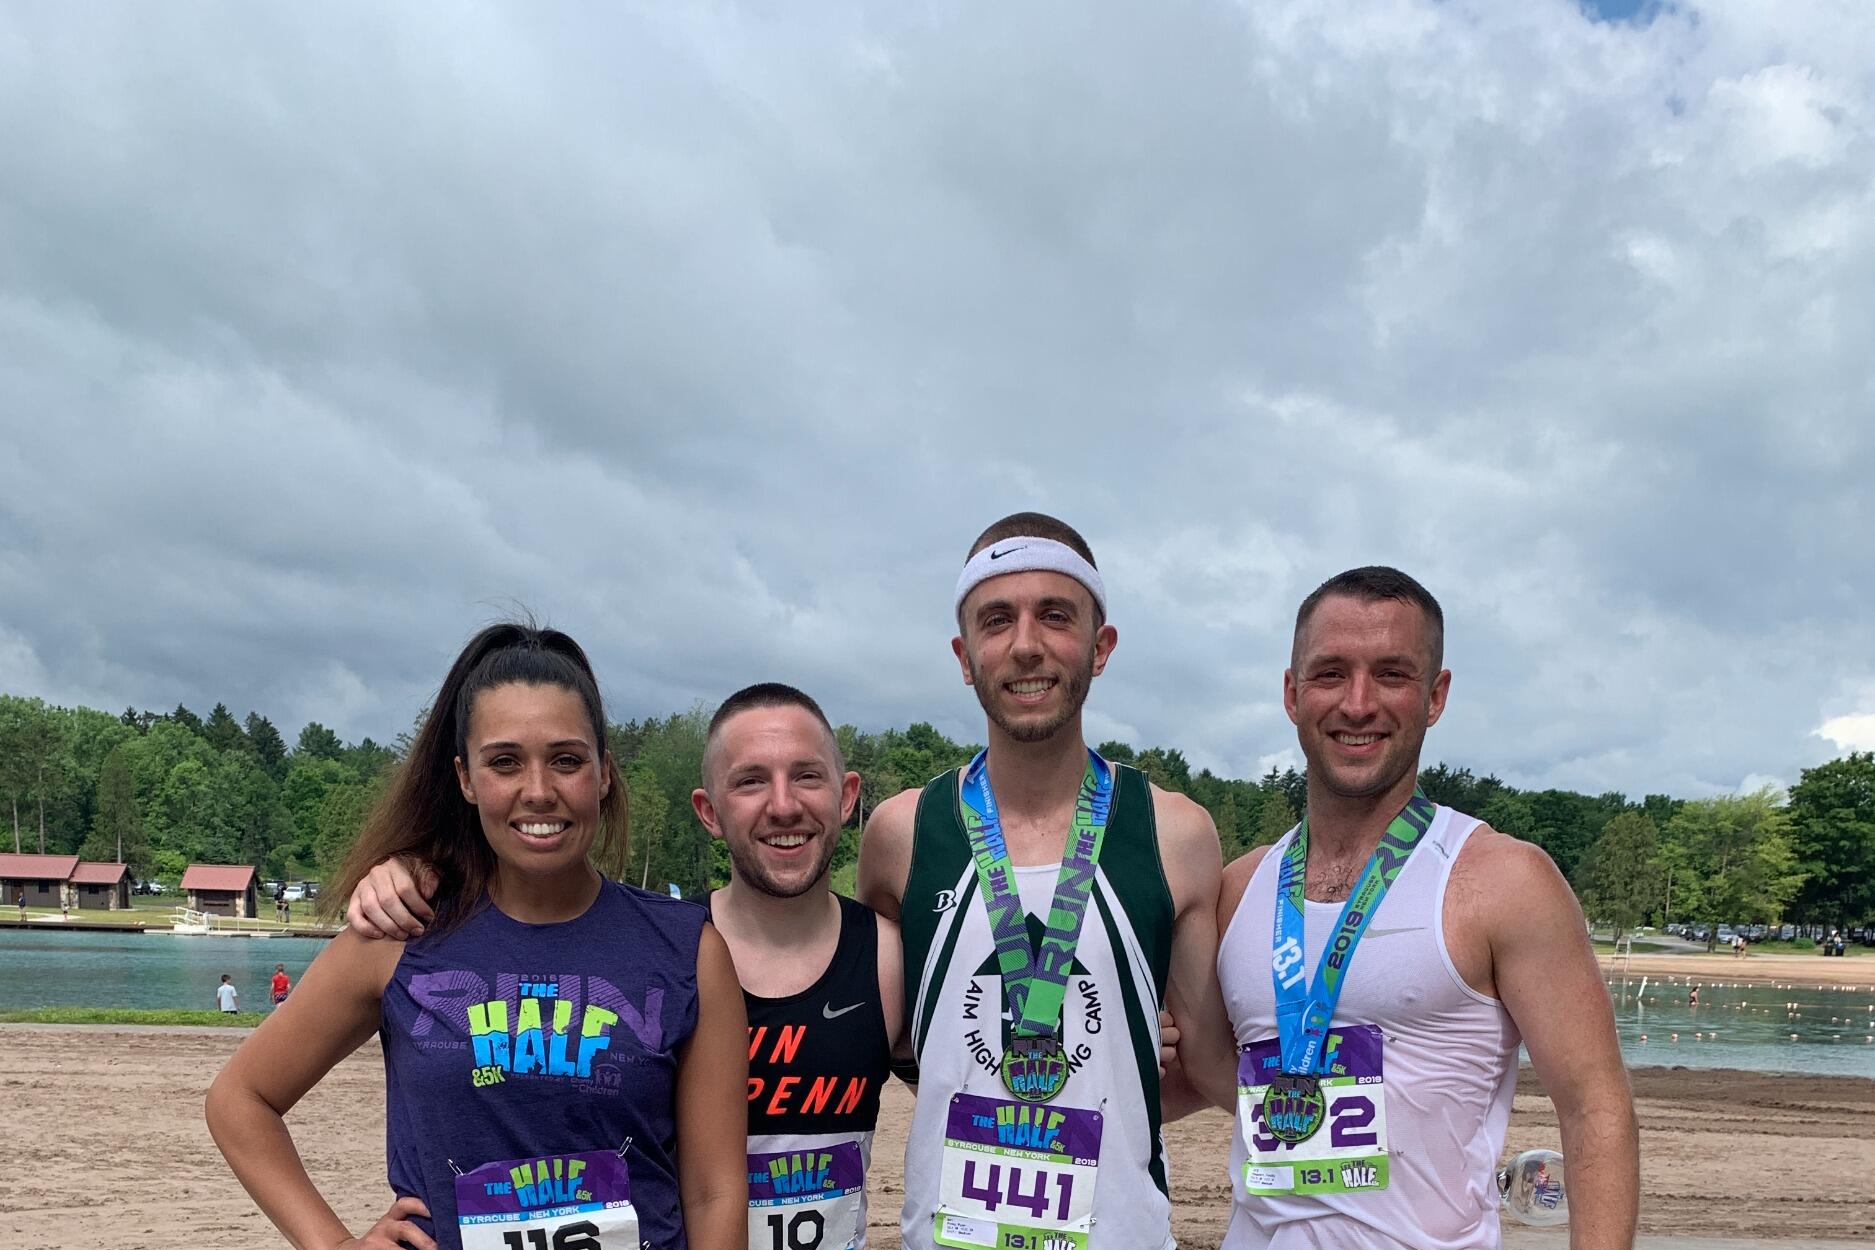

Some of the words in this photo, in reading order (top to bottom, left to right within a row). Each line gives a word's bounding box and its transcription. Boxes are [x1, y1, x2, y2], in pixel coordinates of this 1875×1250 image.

[1035, 858, 1098, 986] RUN
[1274, 899, 1285, 943] FINISHER
[1327, 911, 1364, 970] 2019
[1273, 936, 1305, 990] 13.1
[407, 970, 665, 1051] RUN
[518, 982, 559, 998] THE
[963, 980, 983, 1019] AIM
[1078, 980, 1102, 1034] CAMP
[466, 997, 619, 1079] HALF
[964, 1029, 1000, 1076] HIGH
[471, 1064, 506, 1088] &5K
[1262, 1056, 1281, 1068] THE
[972, 1115, 995, 1129] THE
[996, 1105, 1066, 1149] HALF
[1251, 1096, 1377, 1152] 32
[948, 1140, 997, 1154] SYRACUSE
[1003, 1148, 1023, 1158] NEW
[1026, 1151, 1050, 1161] YORK
[484, 1182, 511, 1195] THE
[509, 1158, 586, 1208] HALF
[768, 1152, 833, 1195] HALF
[961, 1160, 1074, 1221] 441
[1300, 1168, 1334, 1184] 13.1
[1341, 1166, 1377, 1188] HALF
[463, 1213, 520, 1224] SYRACUSE
[529, 1210, 550, 1220] NEW
[553, 1206, 580, 1216] YORK
[781, 1196, 799, 1205] NEW
[801, 1193, 825, 1203] YORK
[1004, 1232, 1037, 1250] 13.1
